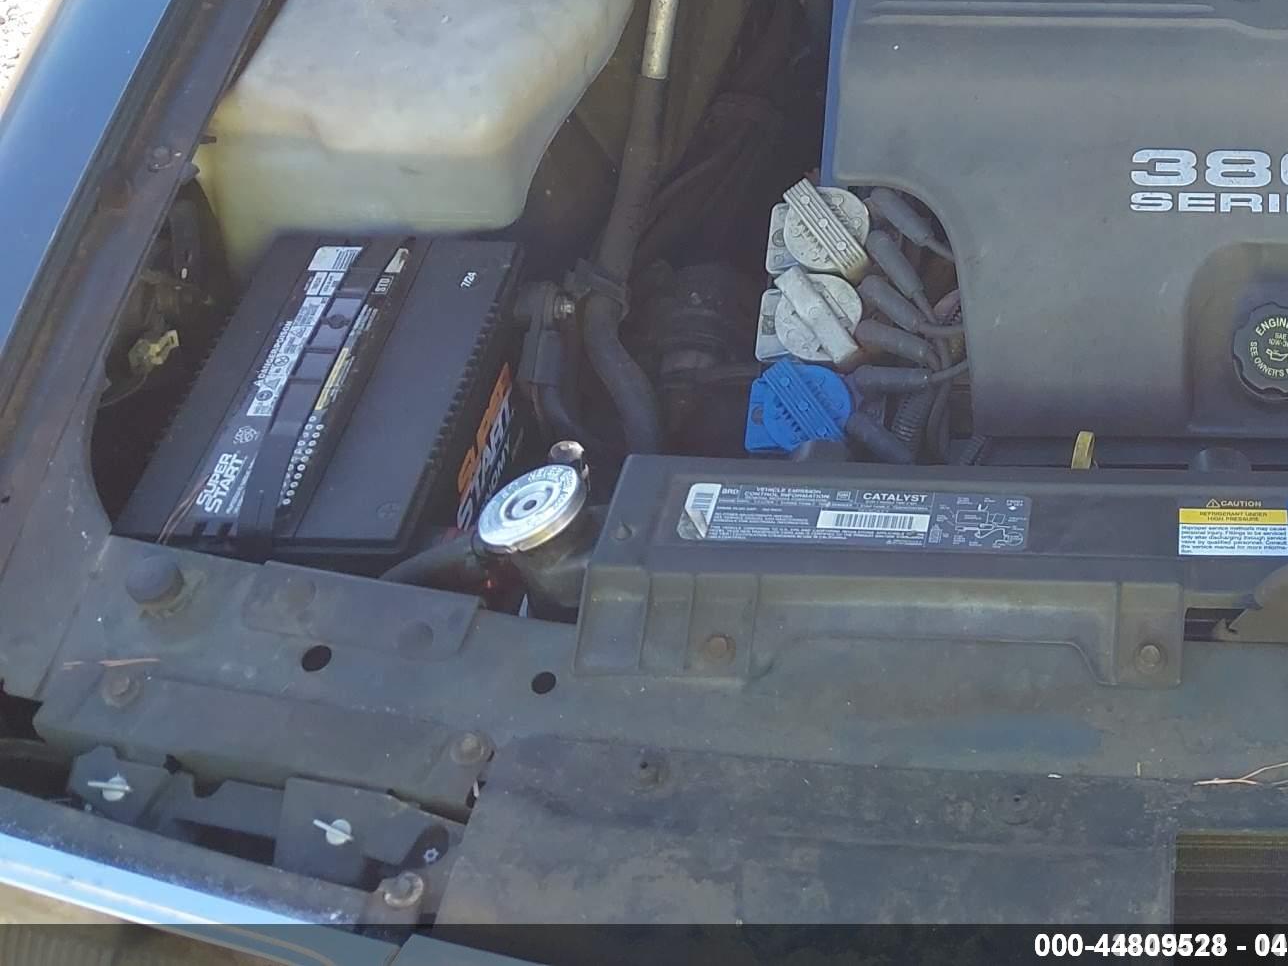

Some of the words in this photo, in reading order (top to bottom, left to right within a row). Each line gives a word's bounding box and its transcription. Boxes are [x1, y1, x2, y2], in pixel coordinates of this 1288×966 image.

[1250, 341, 1259, 358] SEE
[1254, 357, 1285, 377] OWNER'S
[196, 452, 233, 507] SUPER
[205, 453, 245, 514] START
[863, 492, 928, 503] CATALYST
